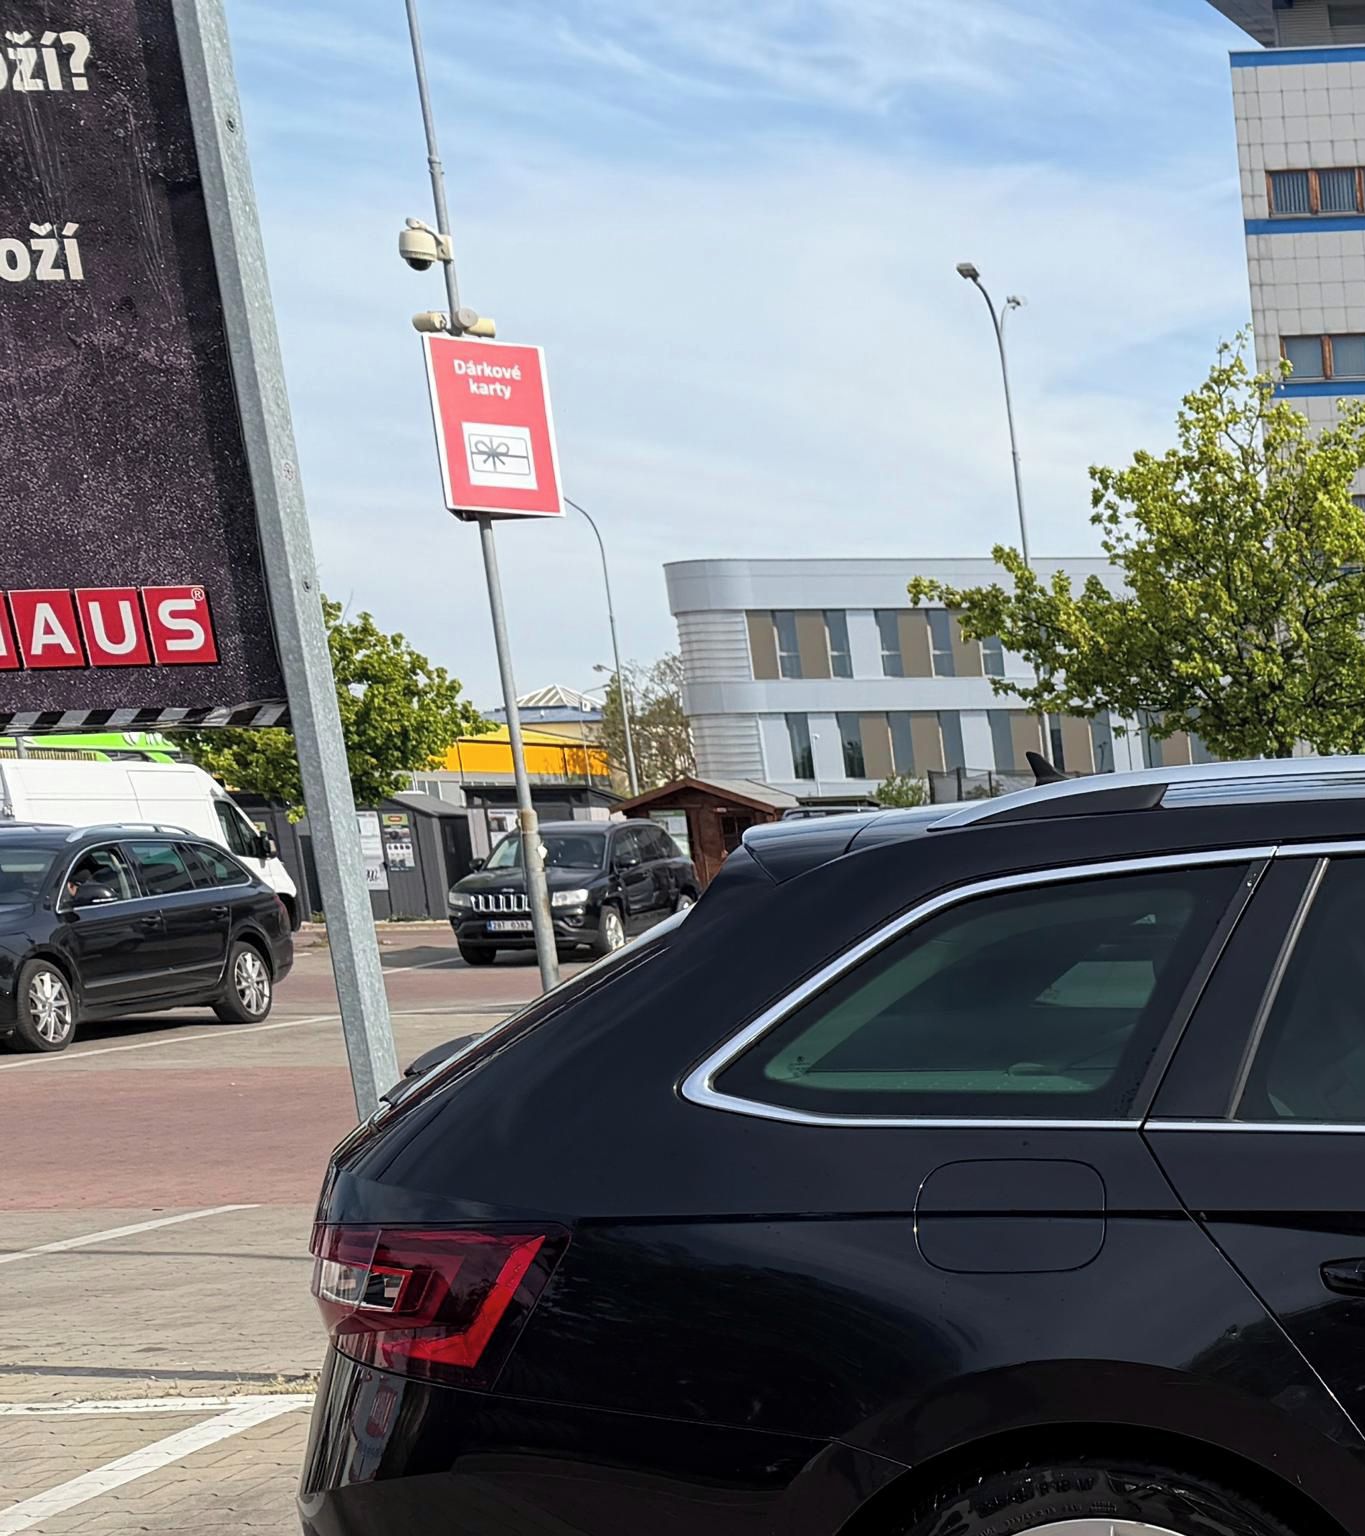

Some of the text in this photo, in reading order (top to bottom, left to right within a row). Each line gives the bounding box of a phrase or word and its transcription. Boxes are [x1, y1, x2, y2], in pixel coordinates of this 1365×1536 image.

[0, 30, 90, 91] ží?
[453, 359, 521, 381] Dárkové
[468, 378, 511, 400] karty
[0, 599, 206, 656] AUS
